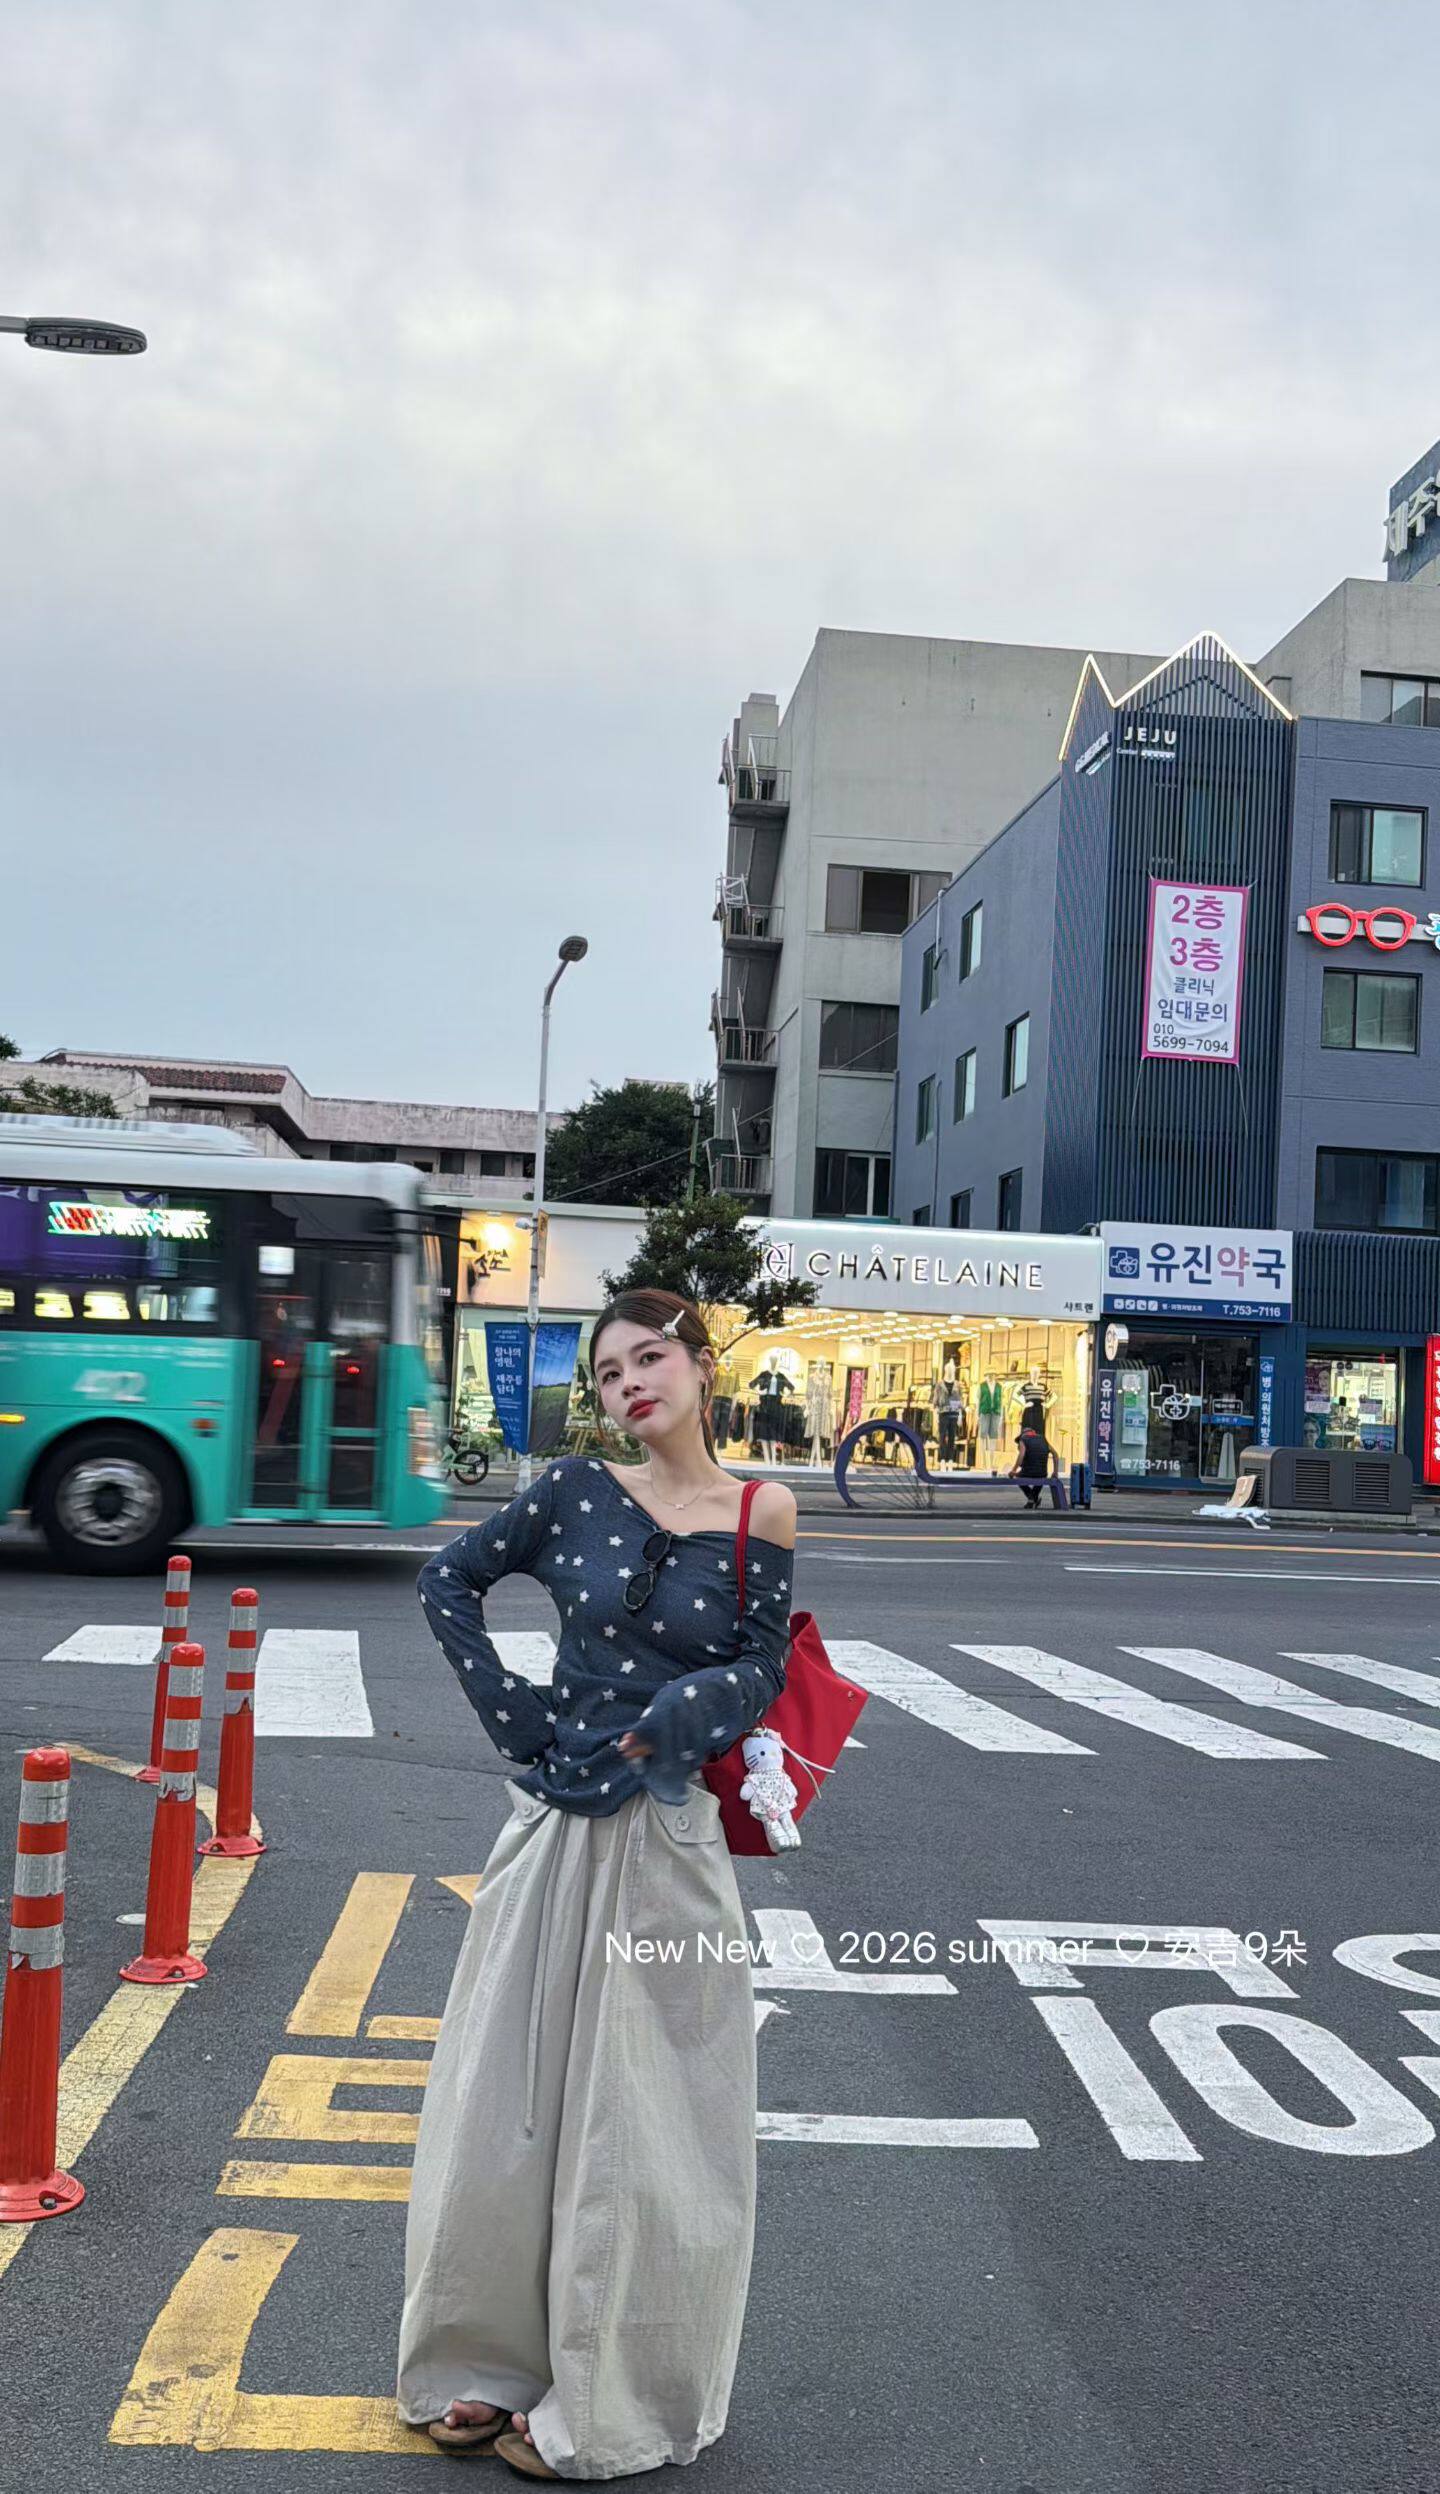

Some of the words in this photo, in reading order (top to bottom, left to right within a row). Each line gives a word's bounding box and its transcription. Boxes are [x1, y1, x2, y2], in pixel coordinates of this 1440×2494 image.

[1382, 469, 1440, 563] 제주
[1124, 726, 1177, 745] JEJU
[1171, 894, 1226, 930] 2층
[1169, 936, 1224, 972] 3층
[1173, 977, 1215, 996] 클리닉
[1157, 999, 1228, 1023] 임대문의
[1153, 1023, 1174, 1035] 010
[1152, 1034, 1229, 1053] 5699-7094
[808, 1244, 1044, 1289] CHÂTELAINE
[1146, 1242, 1286, 1289] 유진약국
[1222, 1304, 1281, 1317] T.753-7116
[1098, 1379, 1113, 1462] 유진약국
[1132, 1458, 1181, 1471] 753-7116
